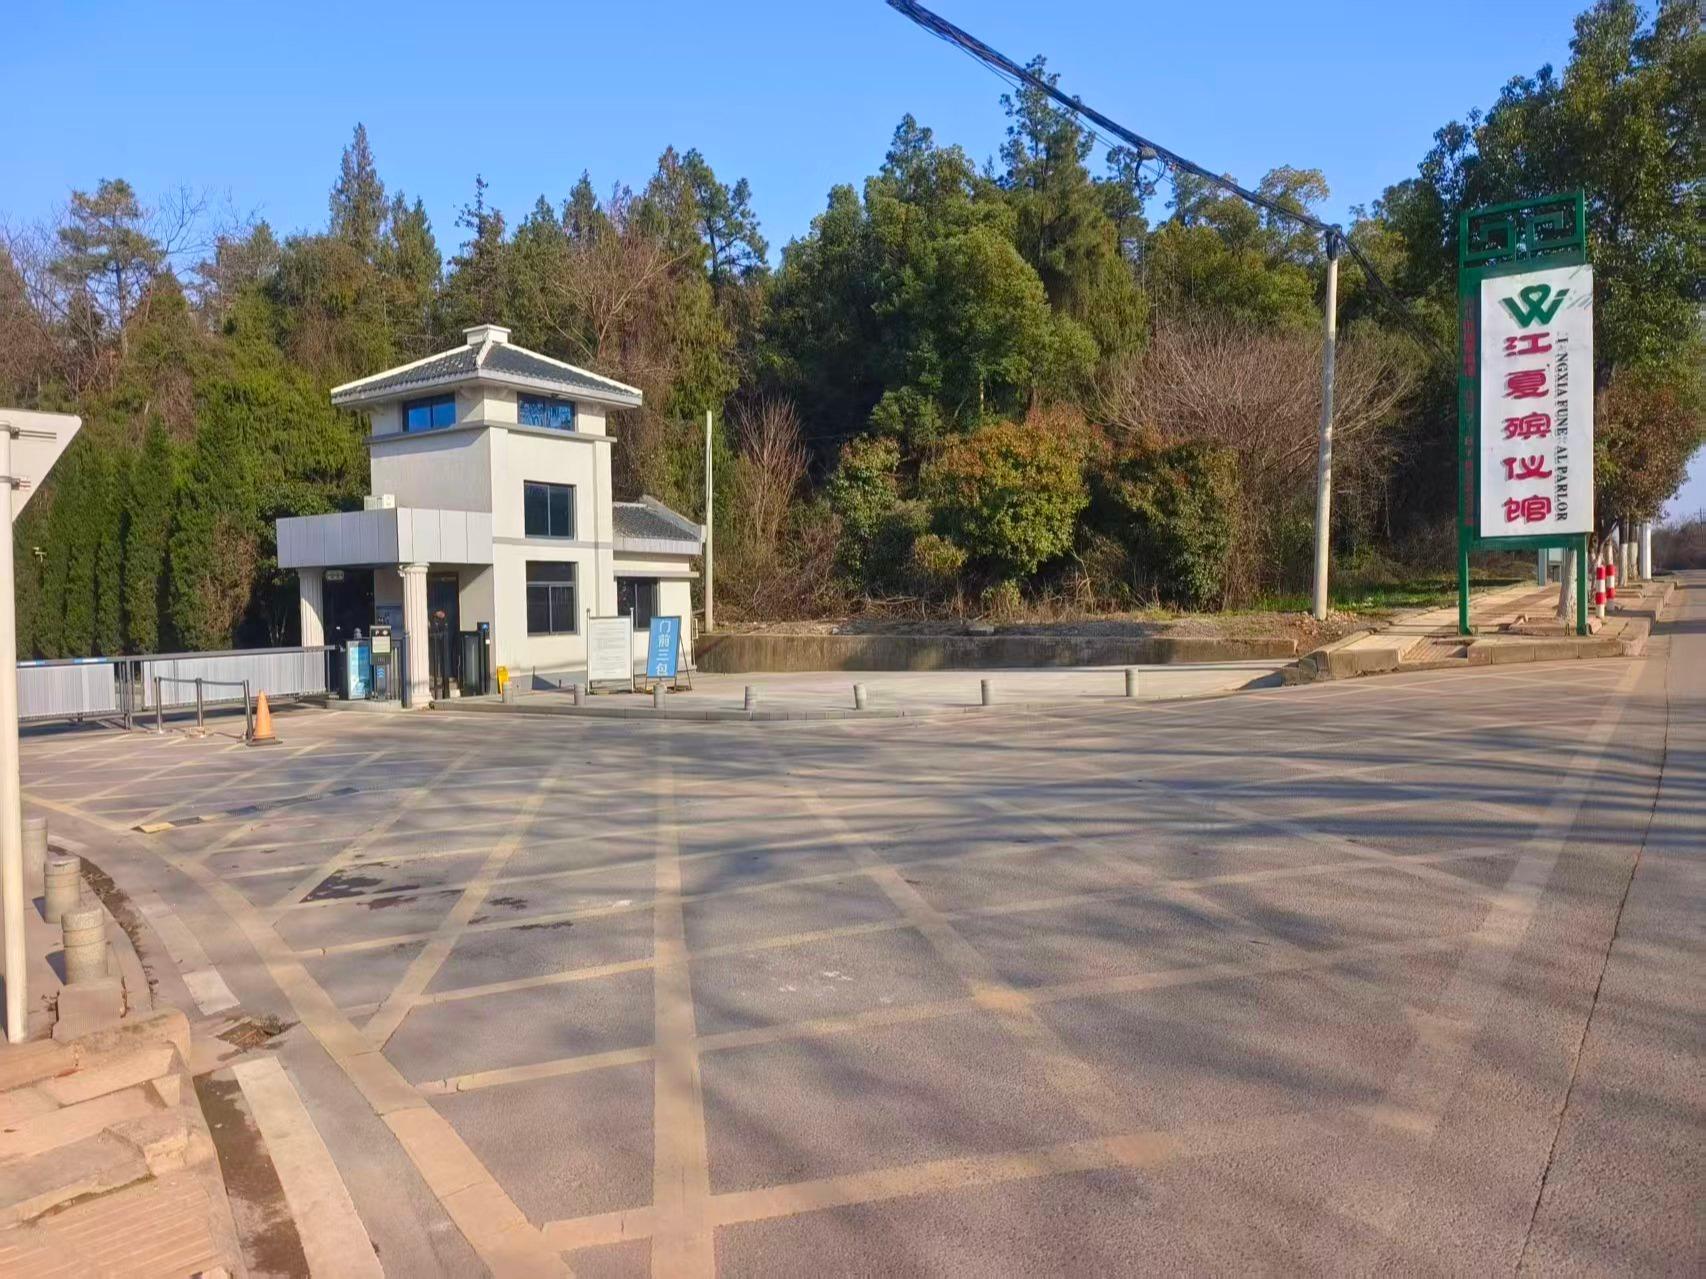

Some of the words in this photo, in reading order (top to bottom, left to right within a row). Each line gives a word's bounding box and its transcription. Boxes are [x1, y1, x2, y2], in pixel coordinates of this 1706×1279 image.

[1503, 331, 1553, 523] 江夏殡仪馆
[1556, 400, 1569, 463] FUNEAL
[1556, 466, 1569, 521] PARLOR
